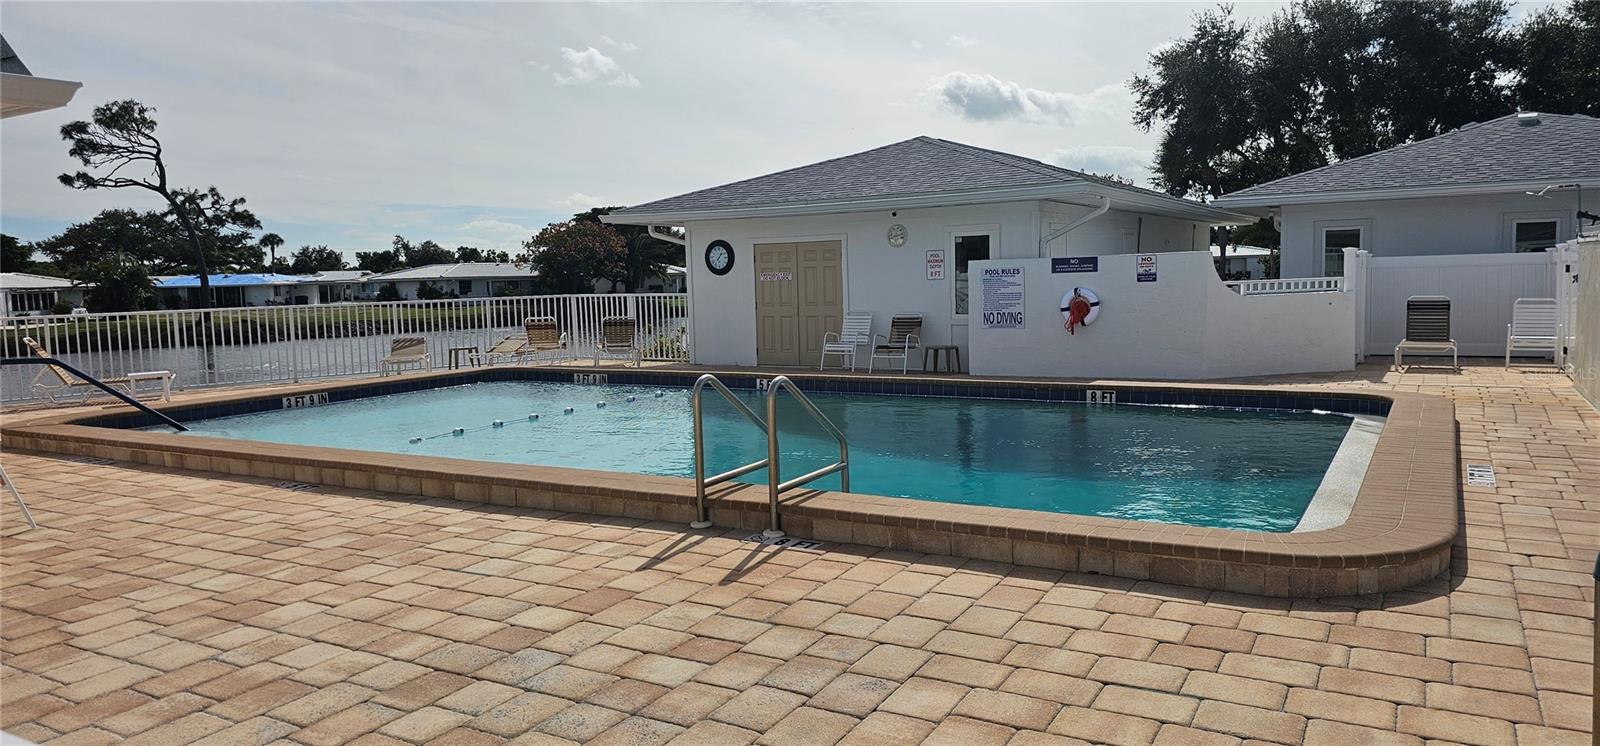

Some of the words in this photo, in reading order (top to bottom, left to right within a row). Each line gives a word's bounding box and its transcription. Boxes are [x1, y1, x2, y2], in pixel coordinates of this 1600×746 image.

[983, 312, 995, 325] NO
[996, 311, 1023, 325] DIVING
[576, 374, 580, 384] 3
[583, 374, 590, 383] FT
[592, 374, 597, 384] 9
[599, 374, 607, 383] IN
[759, 380, 764, 389] 5
[286, 398, 292, 408] 3
[295, 396, 305, 407] FT
[309, 394, 315, 406] 9
[318, 393, 328, 404] IN
[1091, 391, 1097, 402] 8
[1102, 391, 1115, 402] FT
[790, 540, 822, 549] FT
